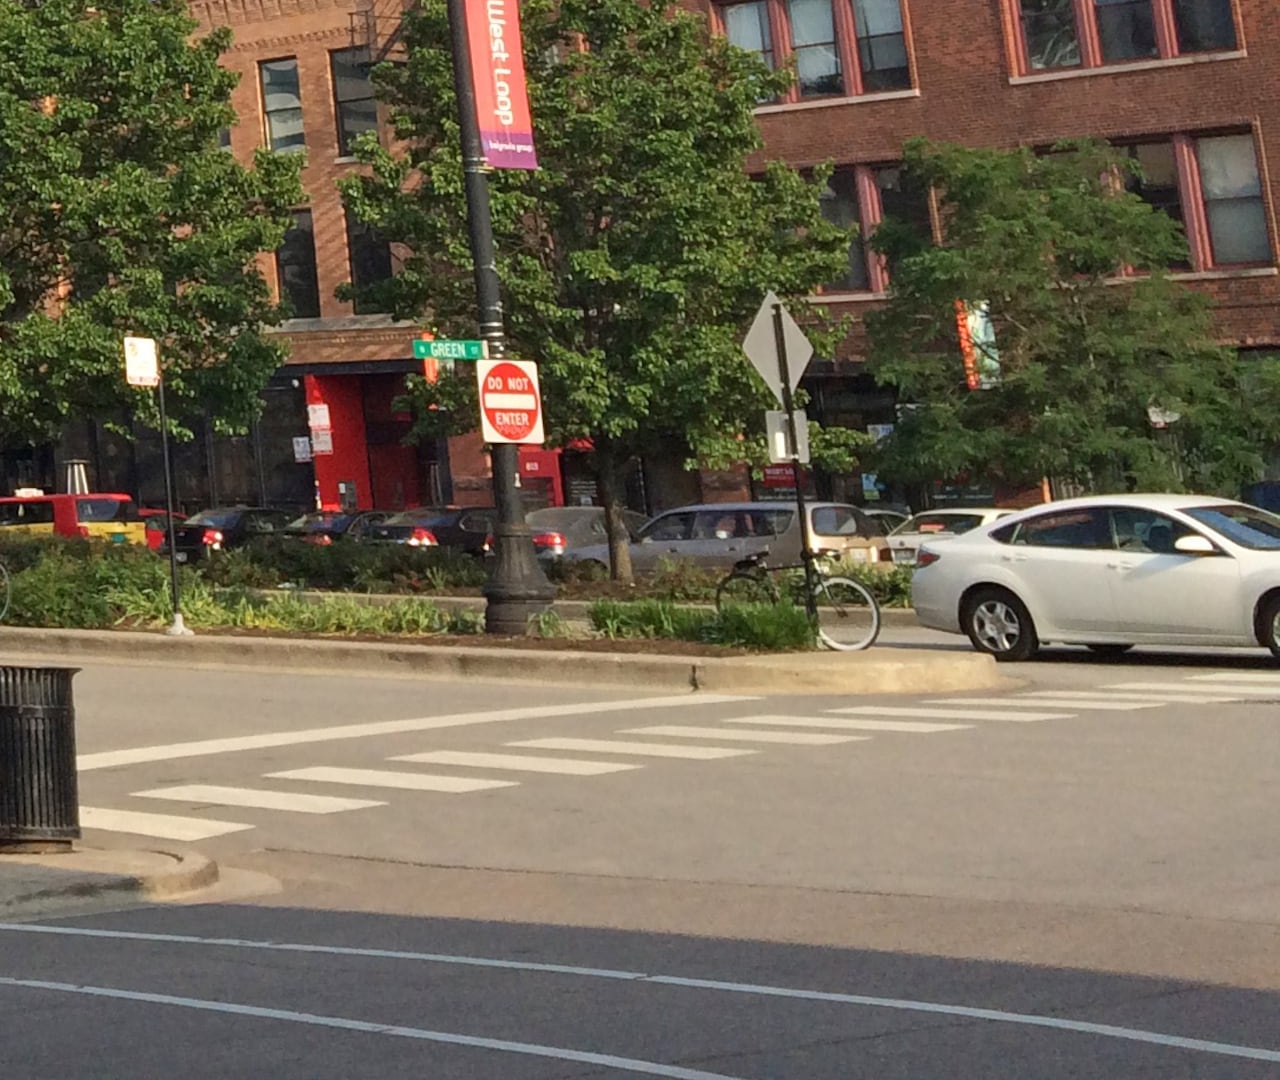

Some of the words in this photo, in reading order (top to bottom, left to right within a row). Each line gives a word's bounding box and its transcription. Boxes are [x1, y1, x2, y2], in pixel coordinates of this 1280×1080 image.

[486, 0, 510, 63] West
[493, 67, 514, 126] Loop
[430, 342, 466, 357] GREEN
[487, 377, 503, 389] DO
[508, 377, 529, 390] NOT
[495, 412, 529, 426] ENTER
